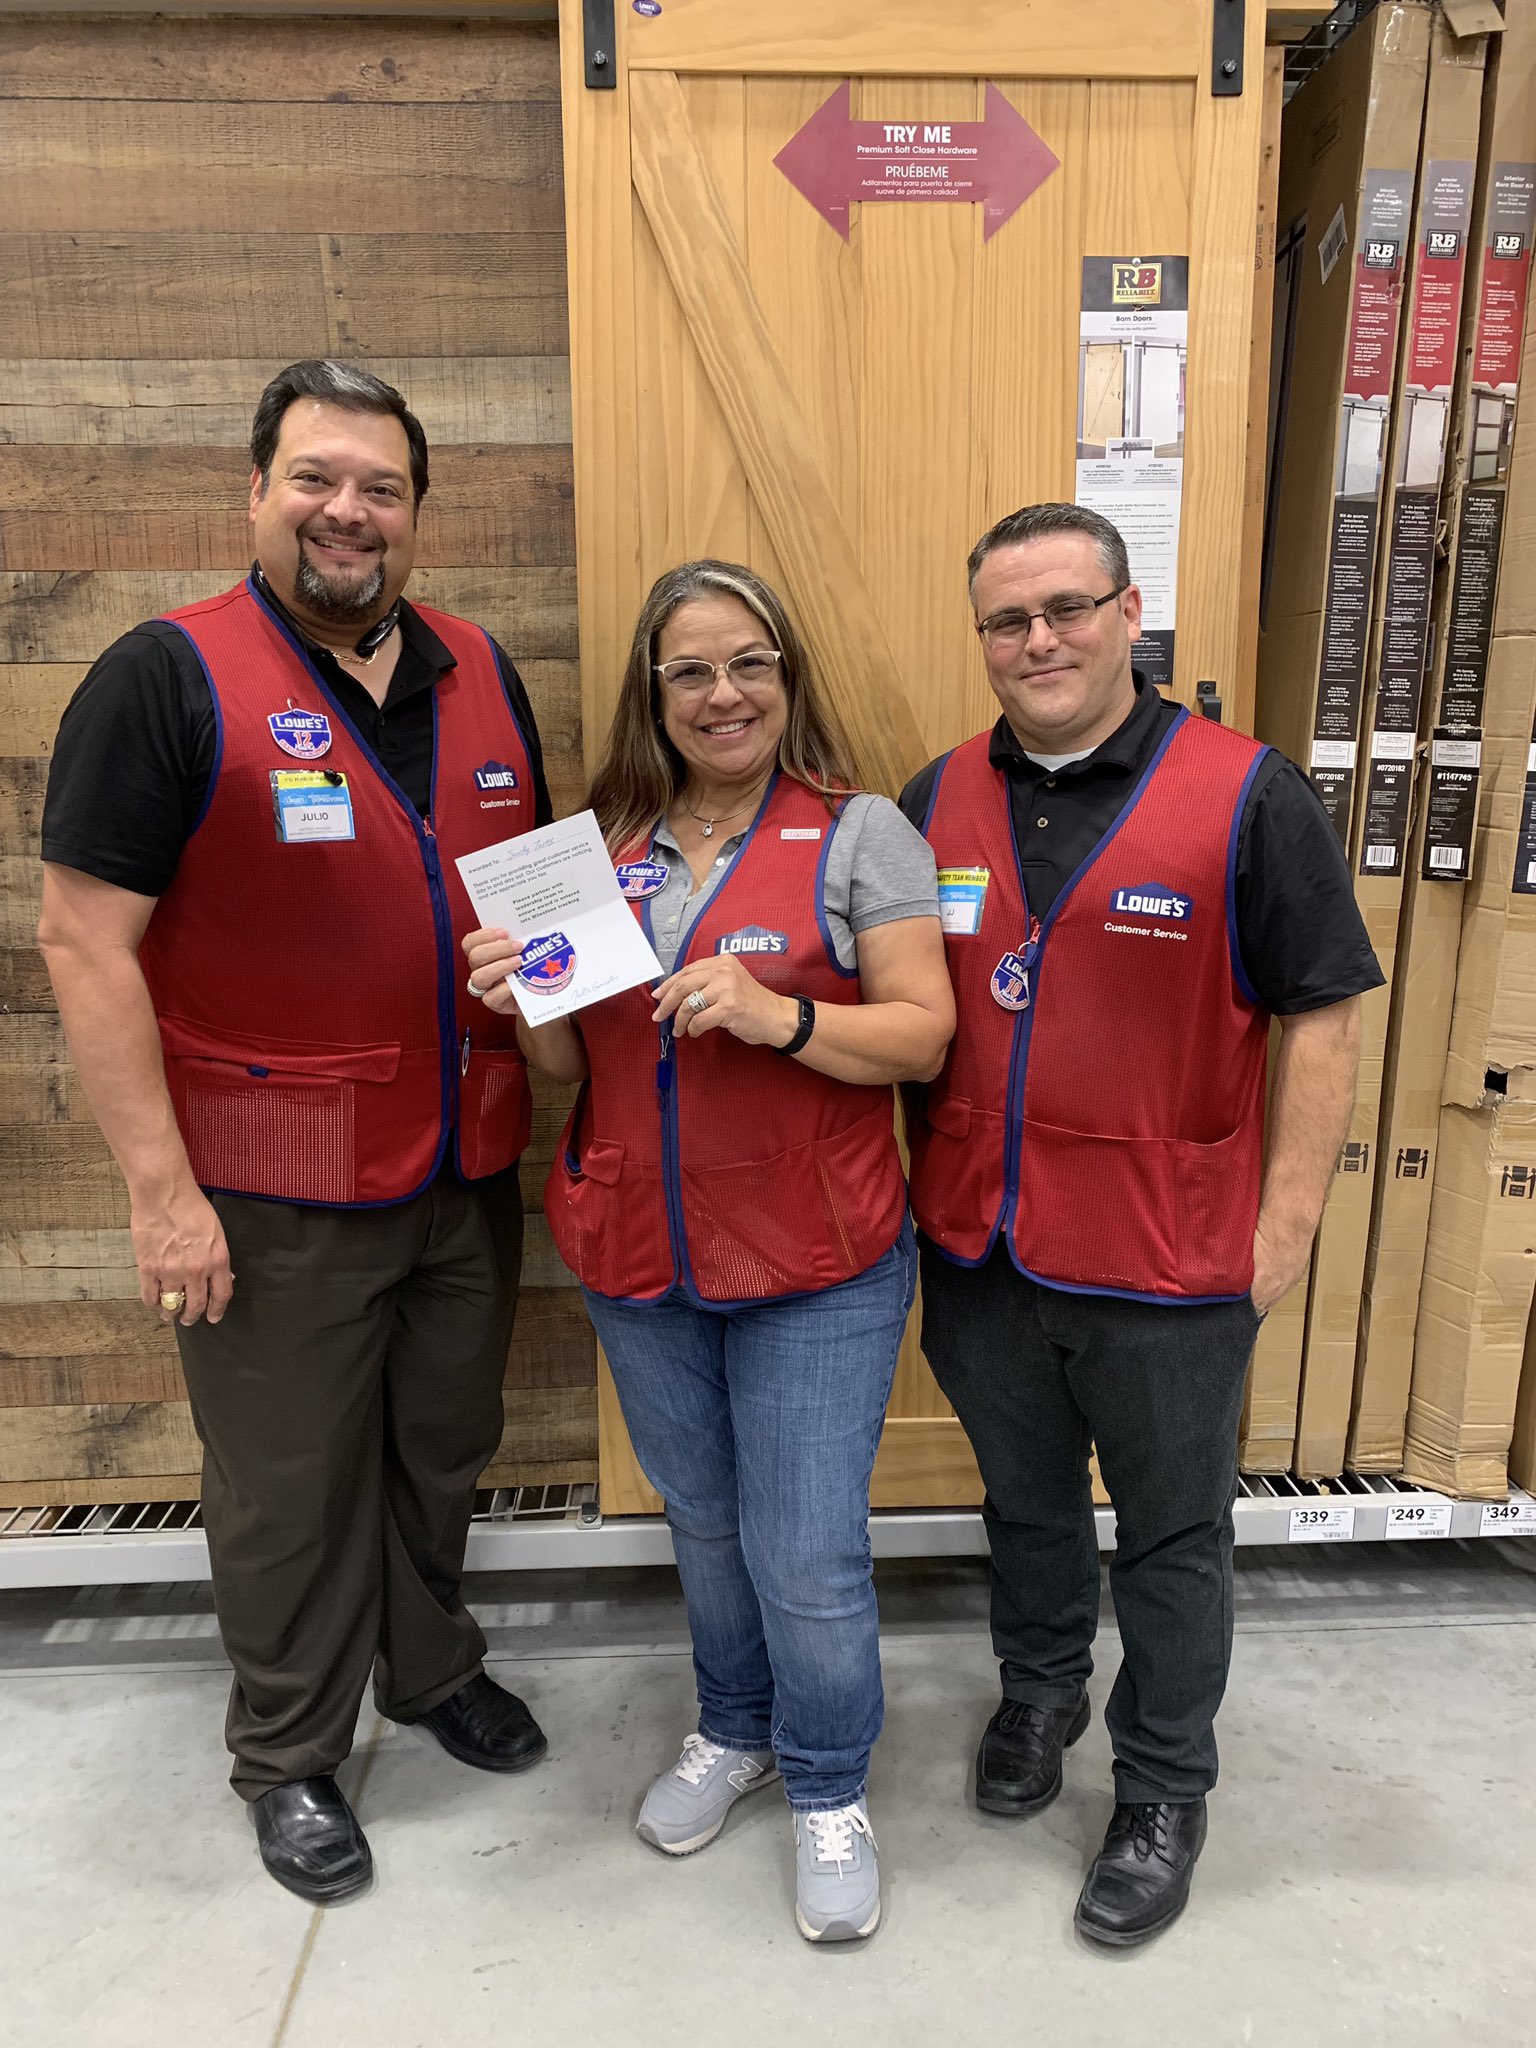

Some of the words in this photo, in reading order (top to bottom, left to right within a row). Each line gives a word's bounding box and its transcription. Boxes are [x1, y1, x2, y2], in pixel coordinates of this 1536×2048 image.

[883, 126, 917, 143] TRY
[923, 126, 951, 143] ME
[857, 145, 893, 155] Premium
[895, 145, 910, 155] Soft
[912, 145, 935, 155] Close
[937, 145, 977, 155] Hardware
[885, 162, 948, 178] PRUÉBEME
[861, 179, 902, 187] Aditamentos
[903, 180, 919, 189] para
[921, 180, 942, 189] puerta
[944, 179, 953, 187] de
[954, 179, 972, 187] cierre
[896, 187, 904, 195] de
[905, 187, 932, 197] primera
[933, 187, 958, 195] calidad
[1430, 233, 1457, 248] RB
[1496, 236, 1521, 250] RB
[1368, 243, 1395, 258] RB
[1116, 268, 1157, 288] RB
[276, 716, 322, 729] LOWE'S
[293, 732, 312, 746] 12
[1376, 764, 1406, 773] #0720182
[476, 771, 514, 788] LOWE'S
[1316, 773, 1345, 781] #0720182
[480, 799, 505, 809] Customer
[301, 812, 329, 822] JULIO
[468, 861, 493, 874] Awarded
[473, 878, 489, 888] Thank
[490, 875, 500, 884] you
[508, 862, 533, 876] providing
[533, 857, 546, 868] great
[547, 849, 570, 861] customer
[571, 841, 589, 852] service
[476, 887, 486, 896] day
[493, 880, 503, 889] and
[504, 877, 515, 885] day
[525, 868, 536, 876] Our
[536, 859, 562, 872] customers
[572, 847, 592, 859] noticing
[620, 866, 662, 877] LOWE'S
[478, 892, 489, 900] and
[499, 879, 527, 894] appreciate
[528, 875, 538, 885] you
[628, 878, 645, 889] 10
[512, 894, 530, 905] Please
[531, 887, 551, 898] partner
[551, 881, 564, 890] with
[515, 898, 543, 911] leadership
[543, 891, 560, 900] team
[518, 907, 536, 917] ensure
[537, 901, 554, 910] award
[560, 889, 580, 901] entered
[531, 907, 557, 919] Milestone
[558, 897, 580, 909] tracking
[1116, 891, 1185, 917] LOWE'S
[1104, 922, 1151, 936] Customer
[1153, 928, 1188, 941] Service
[720, 935, 782, 954] LOWE'S
[1004, 978, 1023, 996] 10
[534, 1007, 557, 1020] Awarded
[1295, 1511, 1328, 1523] $339
[1391, 1508, 1425, 1521] $249
[1486, 1507, 1519, 1519] $349
